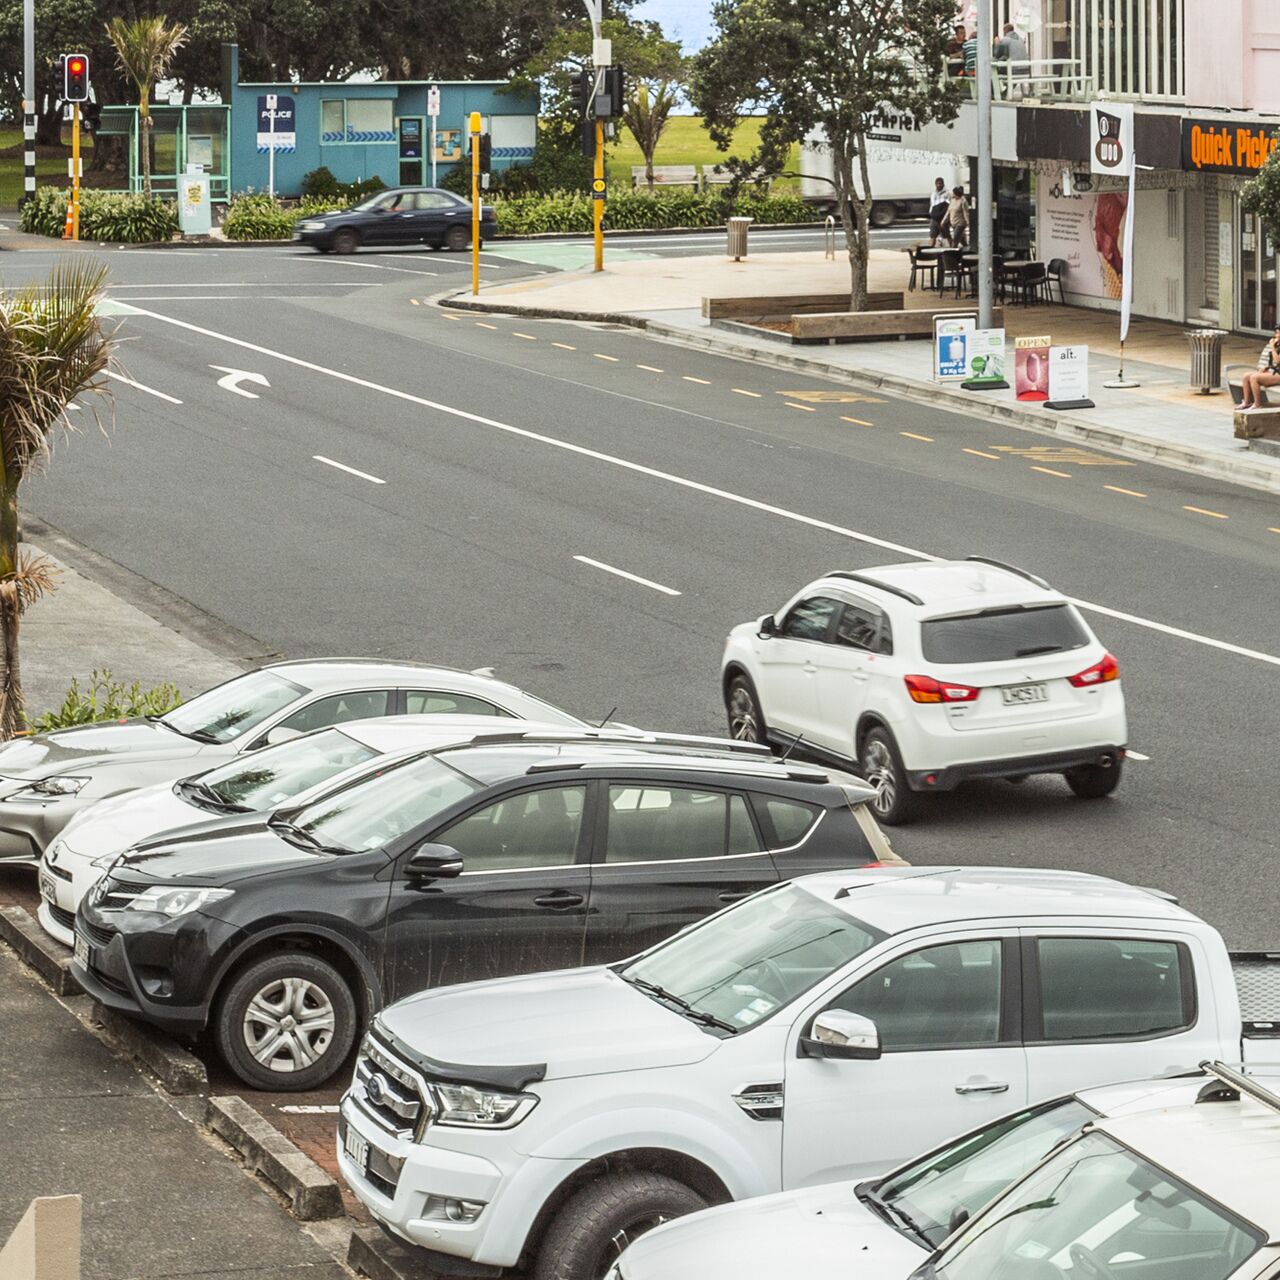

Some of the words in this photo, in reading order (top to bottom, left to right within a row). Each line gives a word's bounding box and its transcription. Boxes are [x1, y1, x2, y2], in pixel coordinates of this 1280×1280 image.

[261, 110, 292, 119] POLICE
[1191, 125, 1233, 169] Quick
[1018, 338, 1048, 347] OPEN
